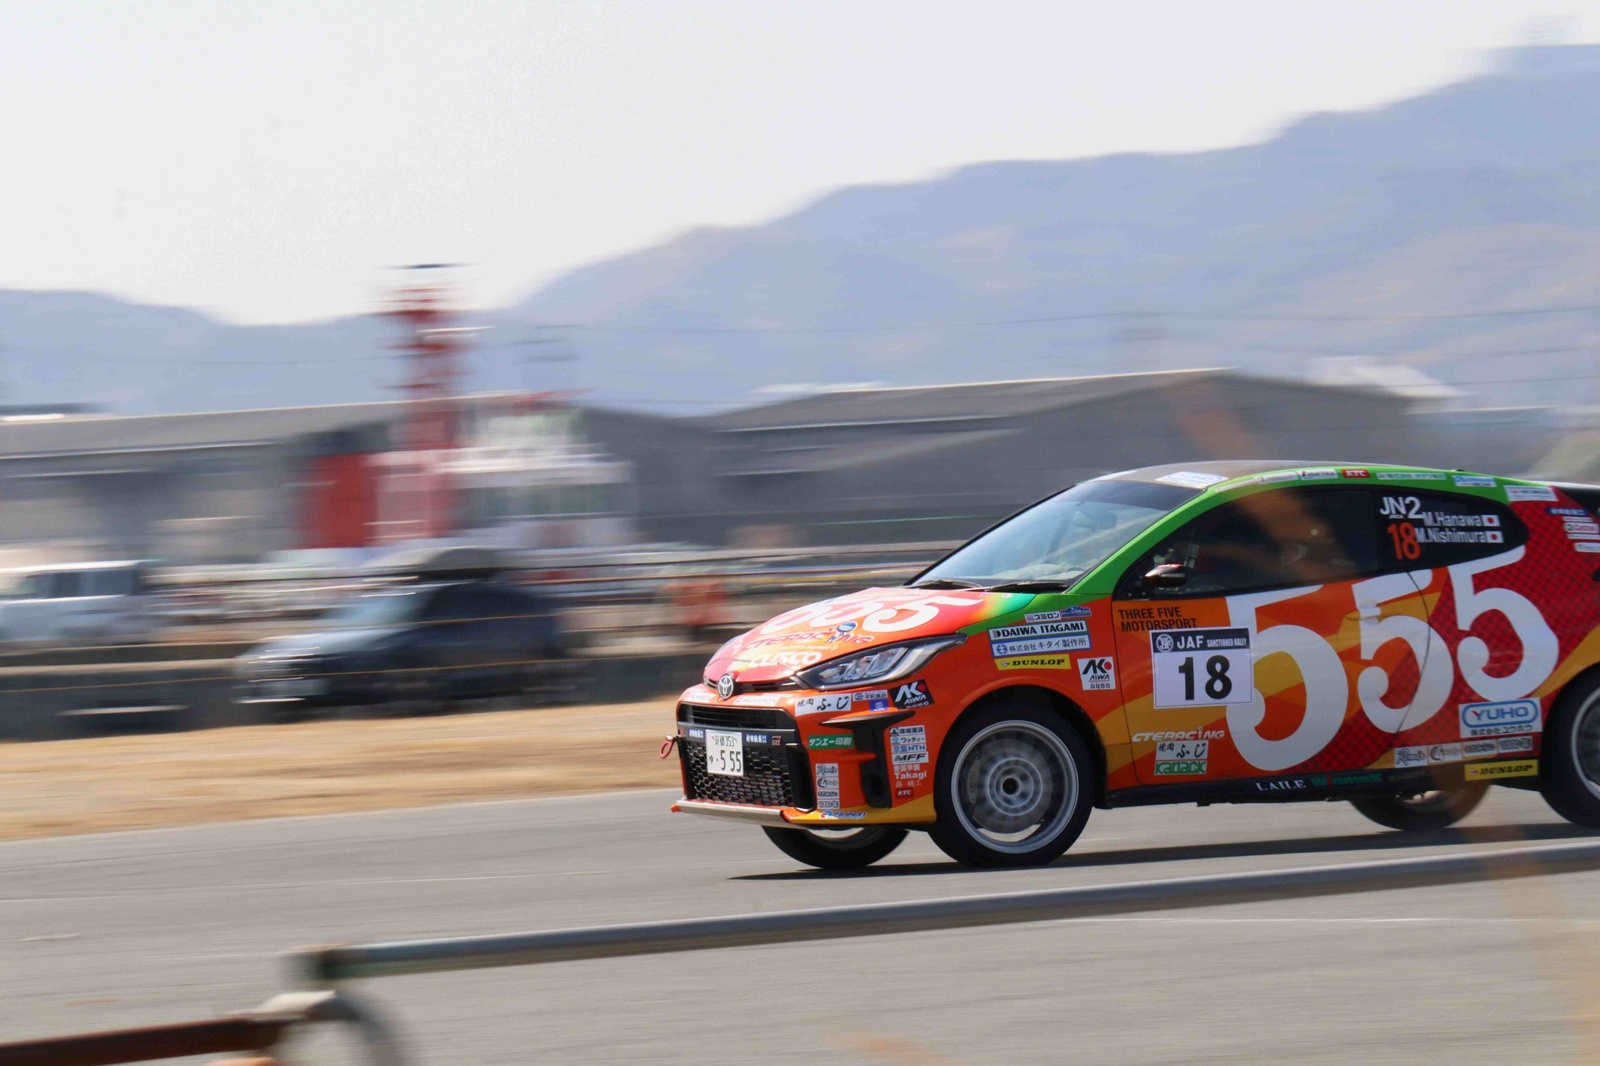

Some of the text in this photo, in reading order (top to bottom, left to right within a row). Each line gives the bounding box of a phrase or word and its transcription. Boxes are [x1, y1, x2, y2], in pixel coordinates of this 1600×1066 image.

[1380, 496, 1424, 518] JN2
[1387, 522, 1421, 560] 18
[1118, 607, 1182, 620] THREE FIVE
[1002, 622, 1084, 637] DAIWA ITAGAMI
[1121, 618, 1197, 632] MOTORSPORT
[1177, 635, 1204, 649] JAF
[1225, 545, 1560, 771] 555
[1178, 655, 1232, 700] 18
[904, 694, 927, 705] AIWA
[1472, 706, 1529, 721] YUHO
[894, 770, 927, 780] Takagi
[1480, 764, 1533, 775] DUNLOP
[1256, 779, 1306, 791] LAILE
